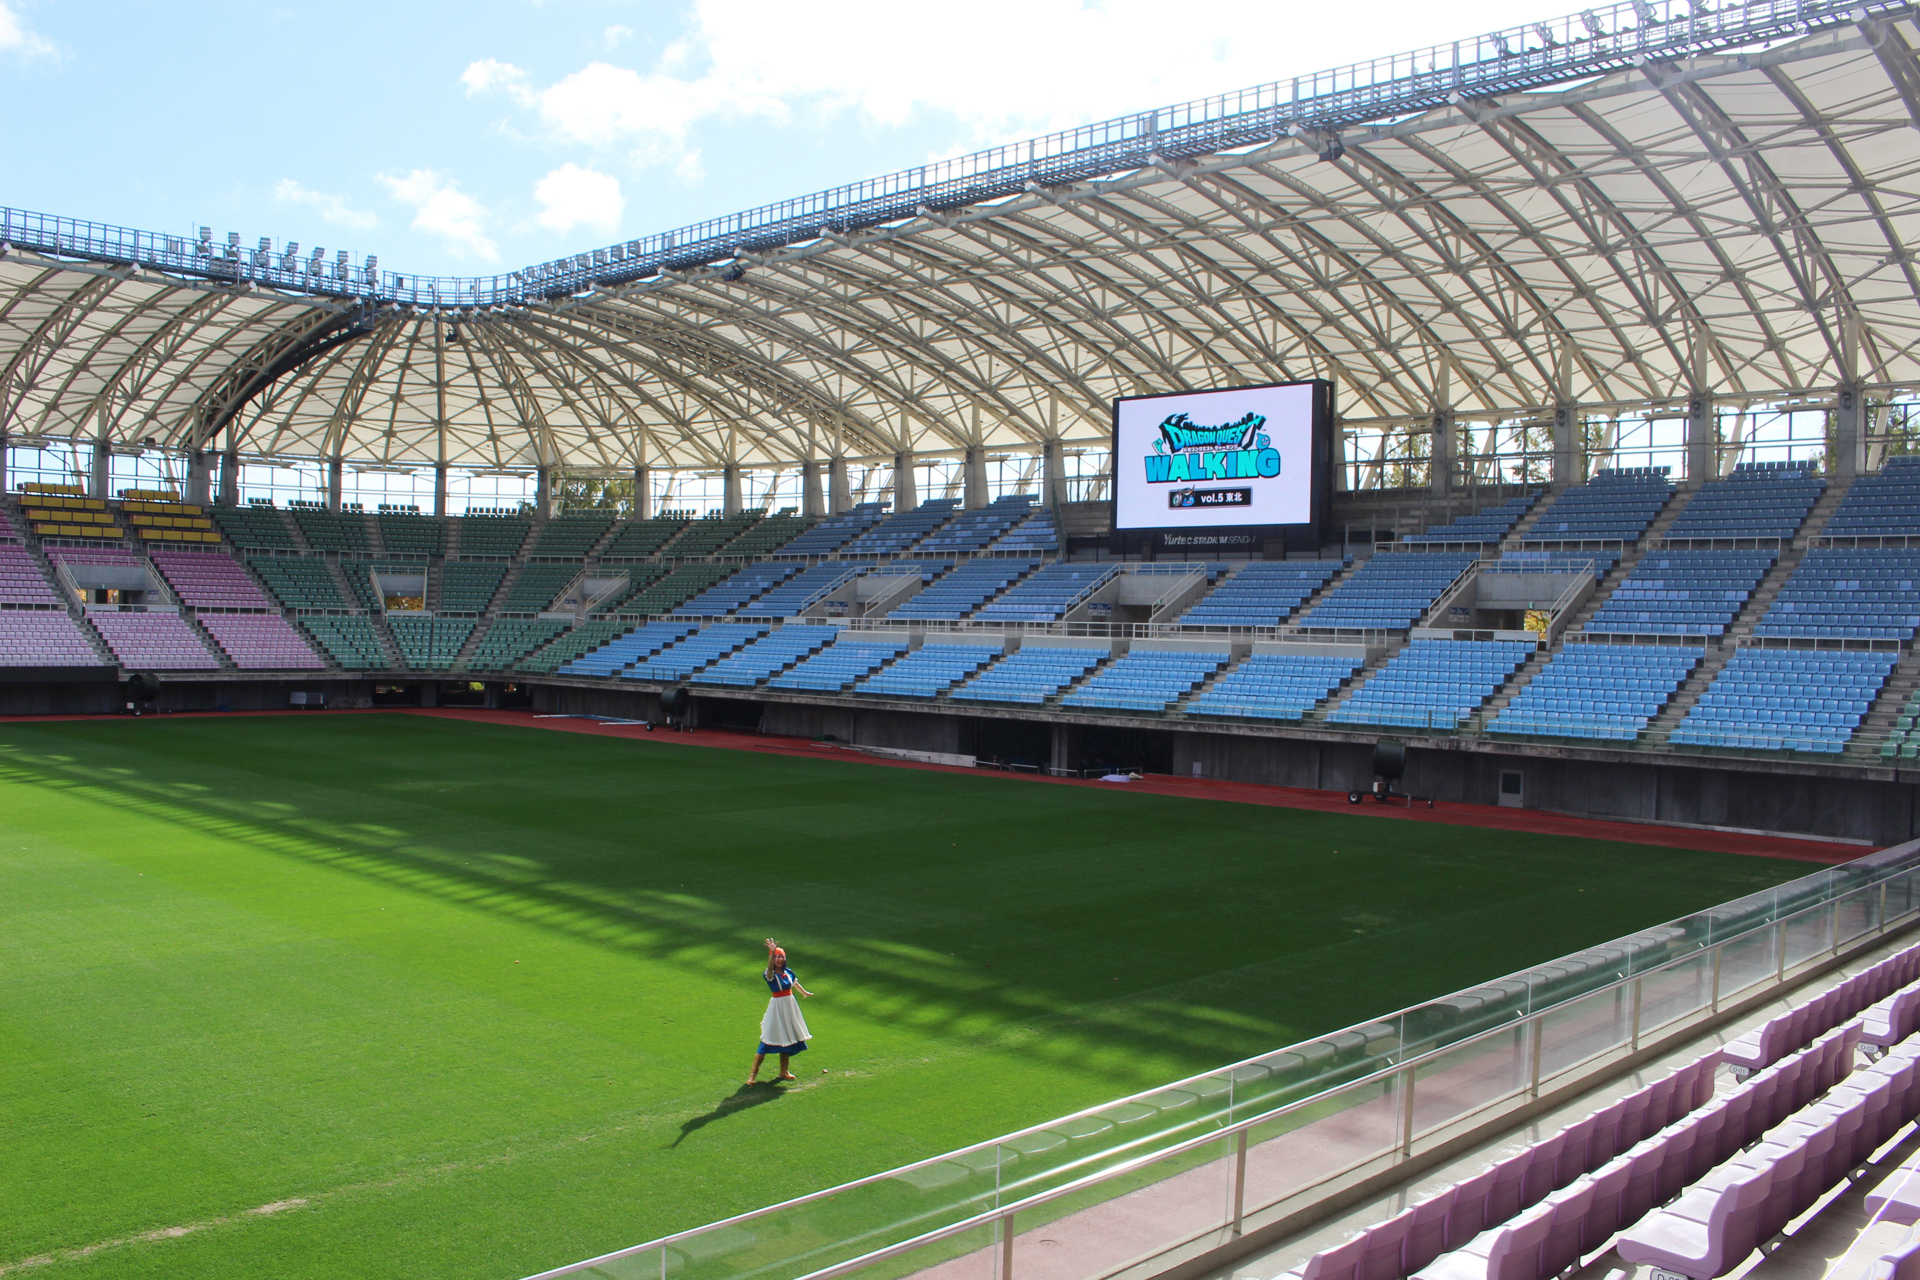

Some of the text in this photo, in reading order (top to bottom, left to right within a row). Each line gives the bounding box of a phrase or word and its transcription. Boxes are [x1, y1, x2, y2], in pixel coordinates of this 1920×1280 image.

[1161, 416, 1265, 452] DRAGON QUEST
[1144, 448, 1281, 484] WALKING
[1200, 492, 1243, 503] vol.5 東北
[1164, 533, 1191, 545] Yurtec
[1191, 536, 1228, 545] STADIUM
[1860, 1044, 1875, 1052] D-02
[1732, 1066, 1745, 1074] D-01
